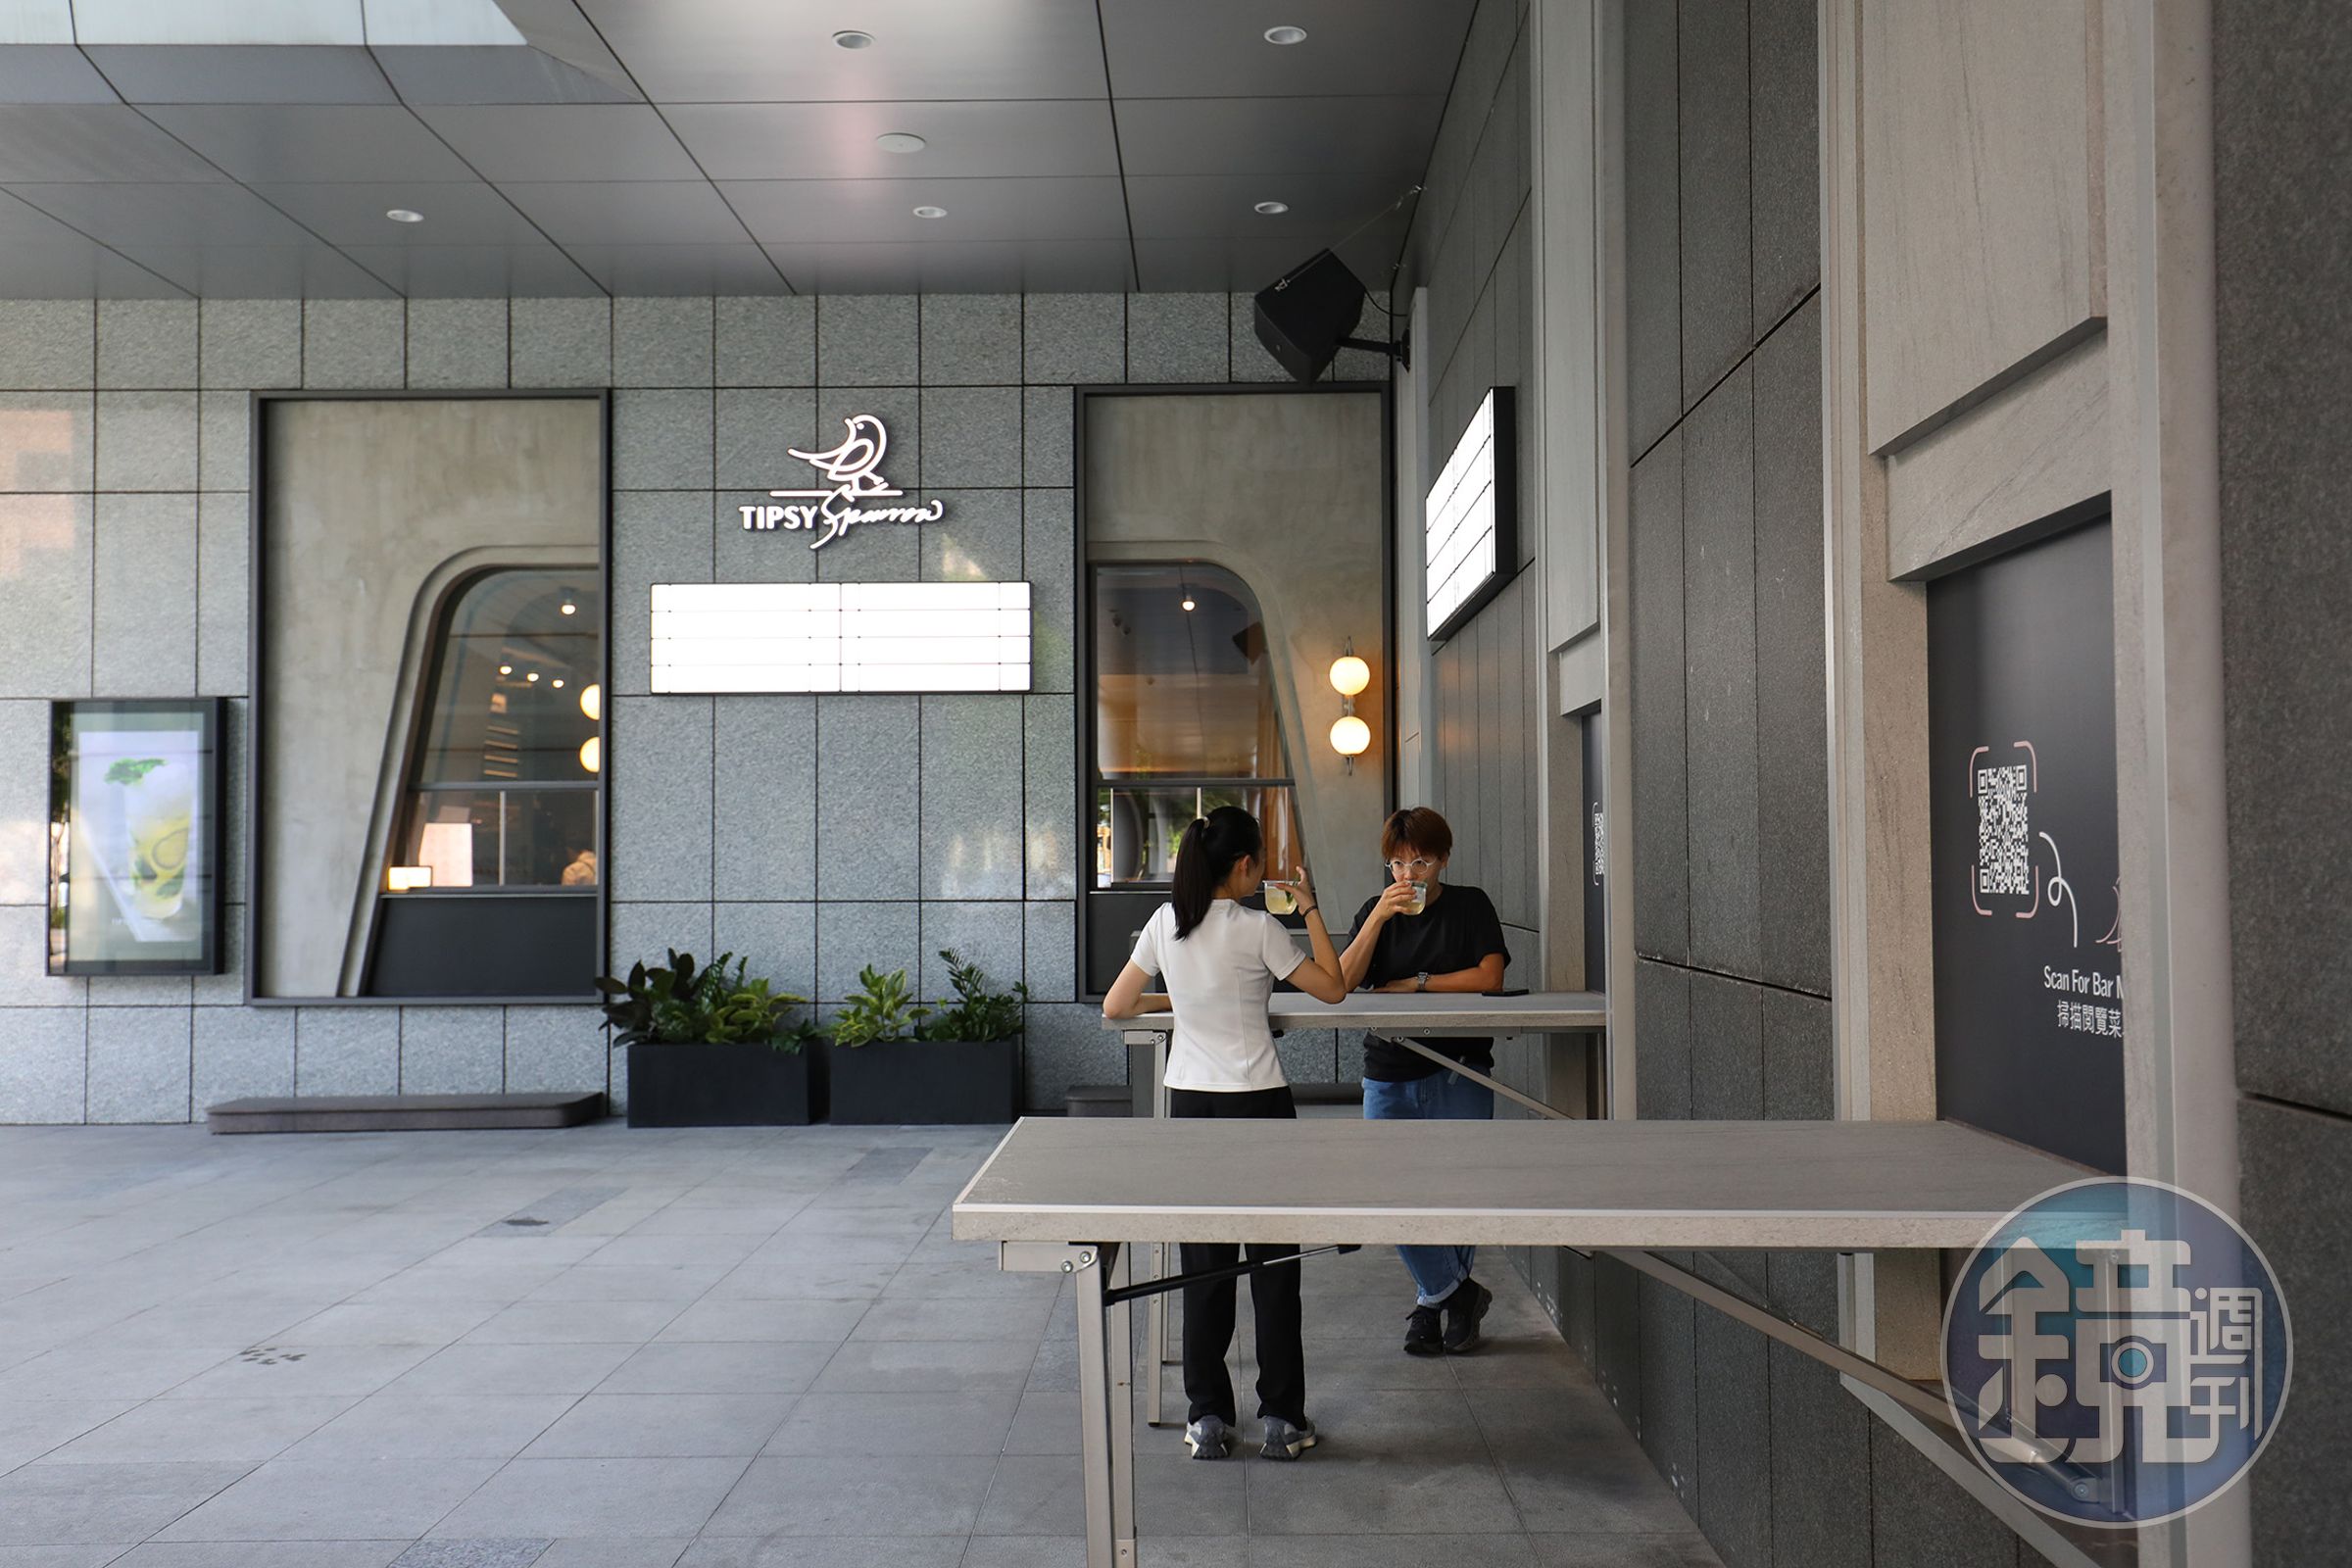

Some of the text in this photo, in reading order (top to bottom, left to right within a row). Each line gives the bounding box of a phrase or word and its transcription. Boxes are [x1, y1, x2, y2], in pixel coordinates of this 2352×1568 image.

[739, 506, 817, 529] TIPSY
[2043, 965, 2070, 991] Scan
[2072, 969, 2090, 994] For
[2092, 972, 2114, 998] Bar
[2057, 1000, 2125, 1038] 掃描閱覽菜
